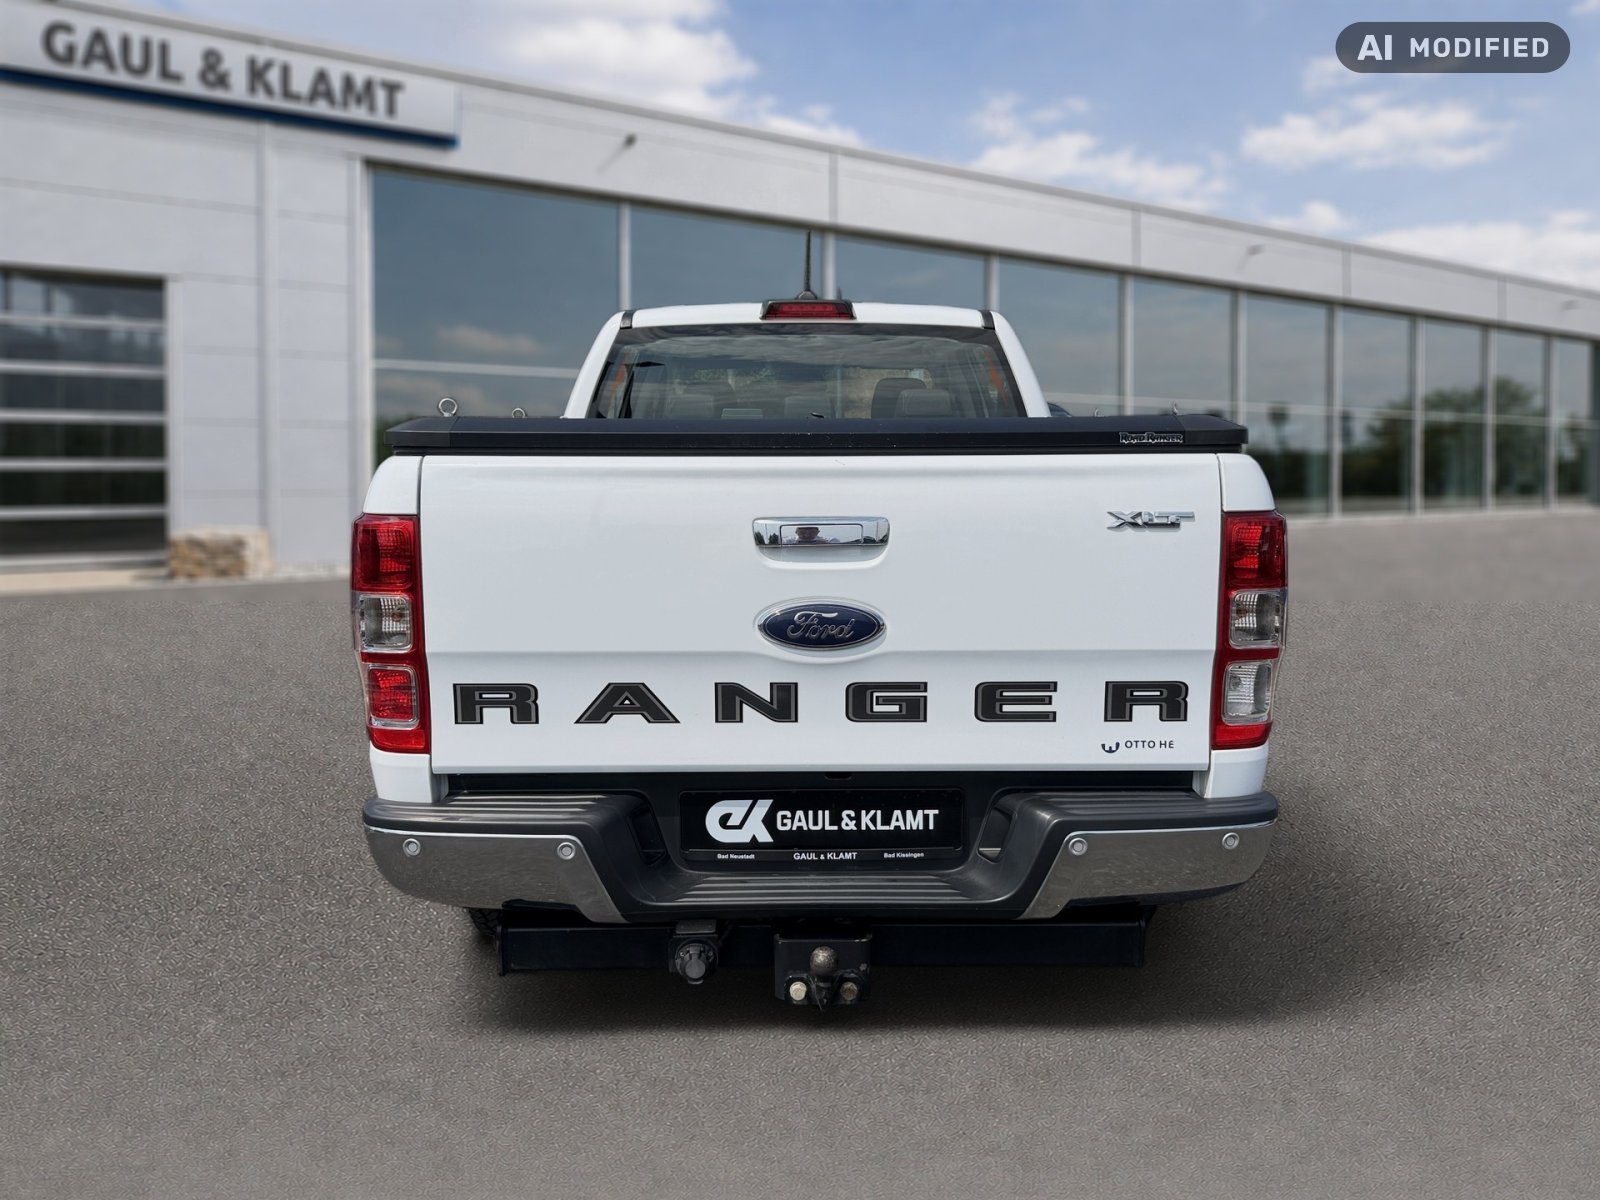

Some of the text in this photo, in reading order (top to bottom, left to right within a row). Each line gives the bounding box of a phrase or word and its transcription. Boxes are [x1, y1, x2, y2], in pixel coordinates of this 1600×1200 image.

[41, 20, 406, 119] GAUL & KLAMT
[1106, 511, 1195, 531] XLT
[787, 610, 855, 639] Ford
[453, 681, 1189, 725] RANGER
[1124, 739, 1174, 749] OTTO HE
[776, 809, 940, 831] GAUL & KLAMT
[793, 852, 818, 860] GAUL
[827, 852, 858, 860] KLAMT
[896, 852, 925, 860] Kissingen
